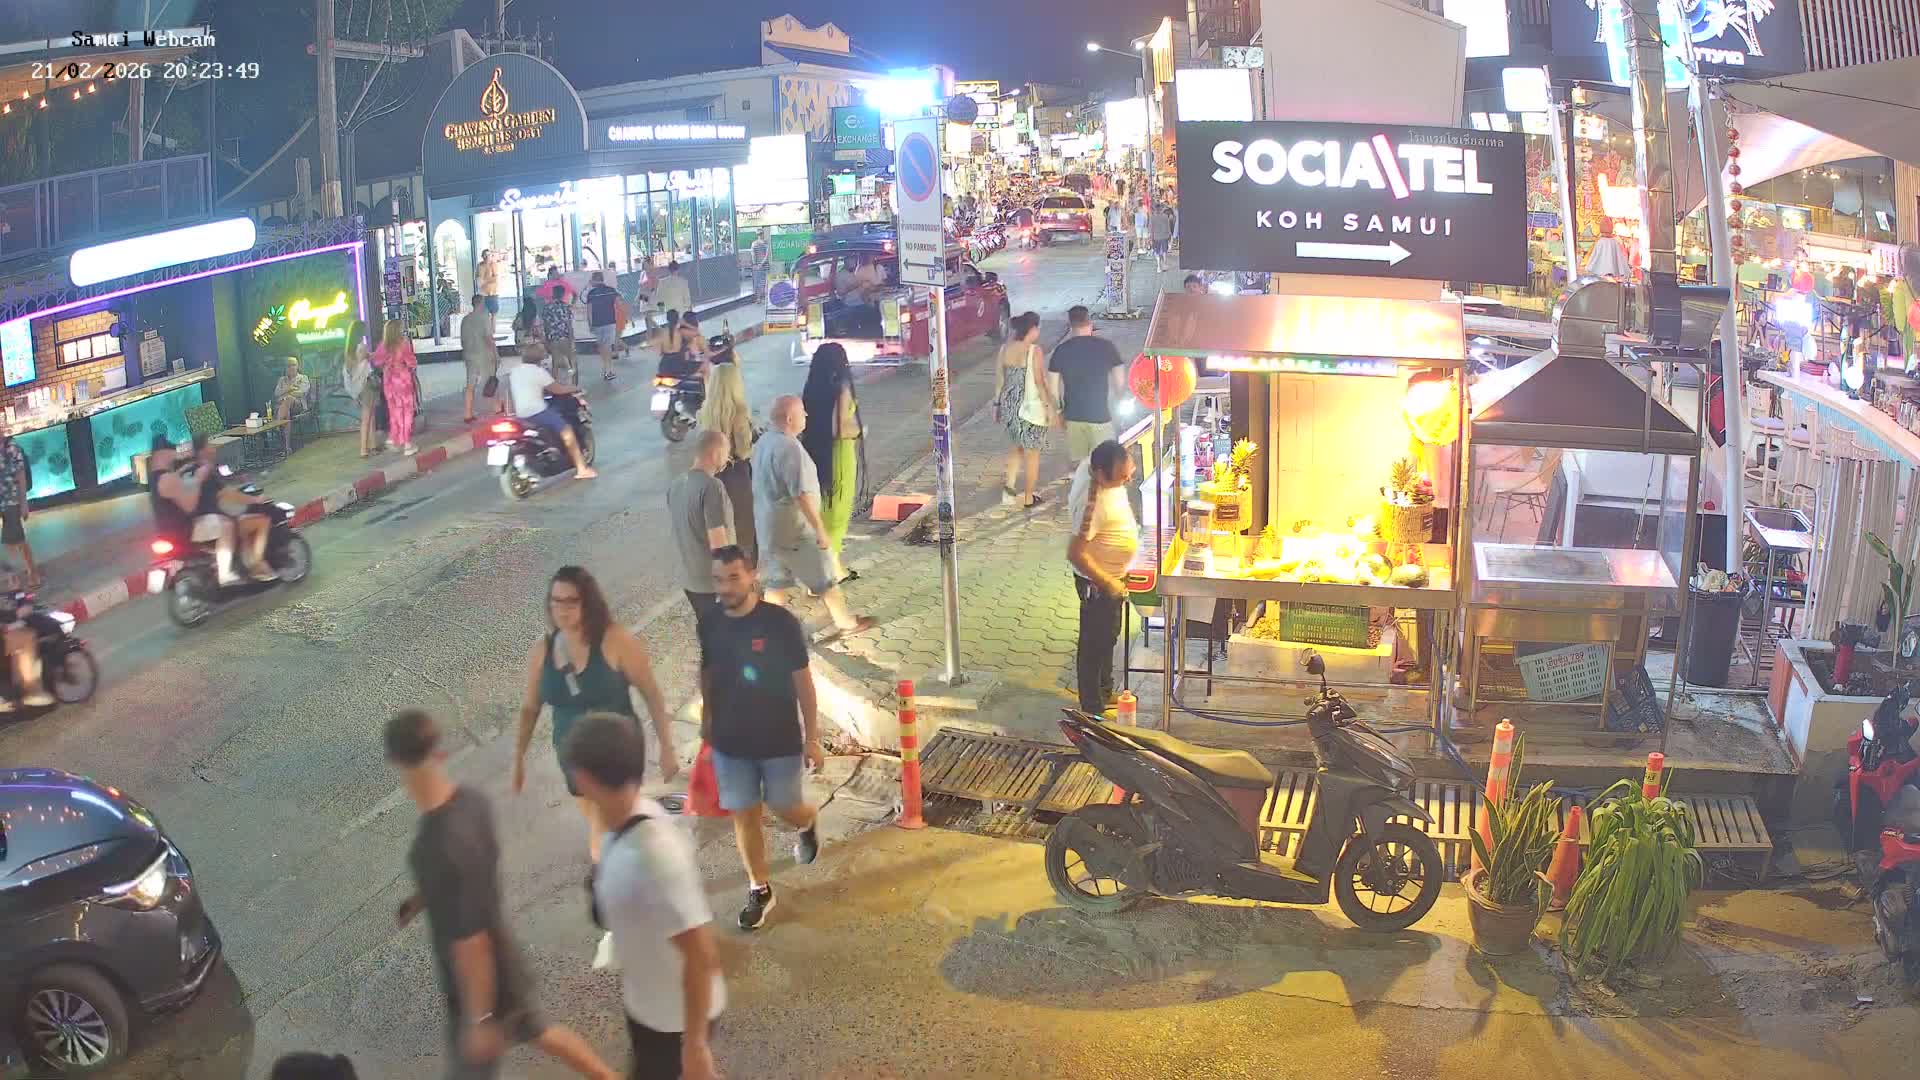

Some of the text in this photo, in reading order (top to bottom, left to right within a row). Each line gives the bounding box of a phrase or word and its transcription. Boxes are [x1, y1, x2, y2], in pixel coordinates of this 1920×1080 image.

[837, 134, 878, 145] EXCHANGE
[1256, 210, 1452, 236] KOH SAMUI
[905, 242, 912, 250] NO
